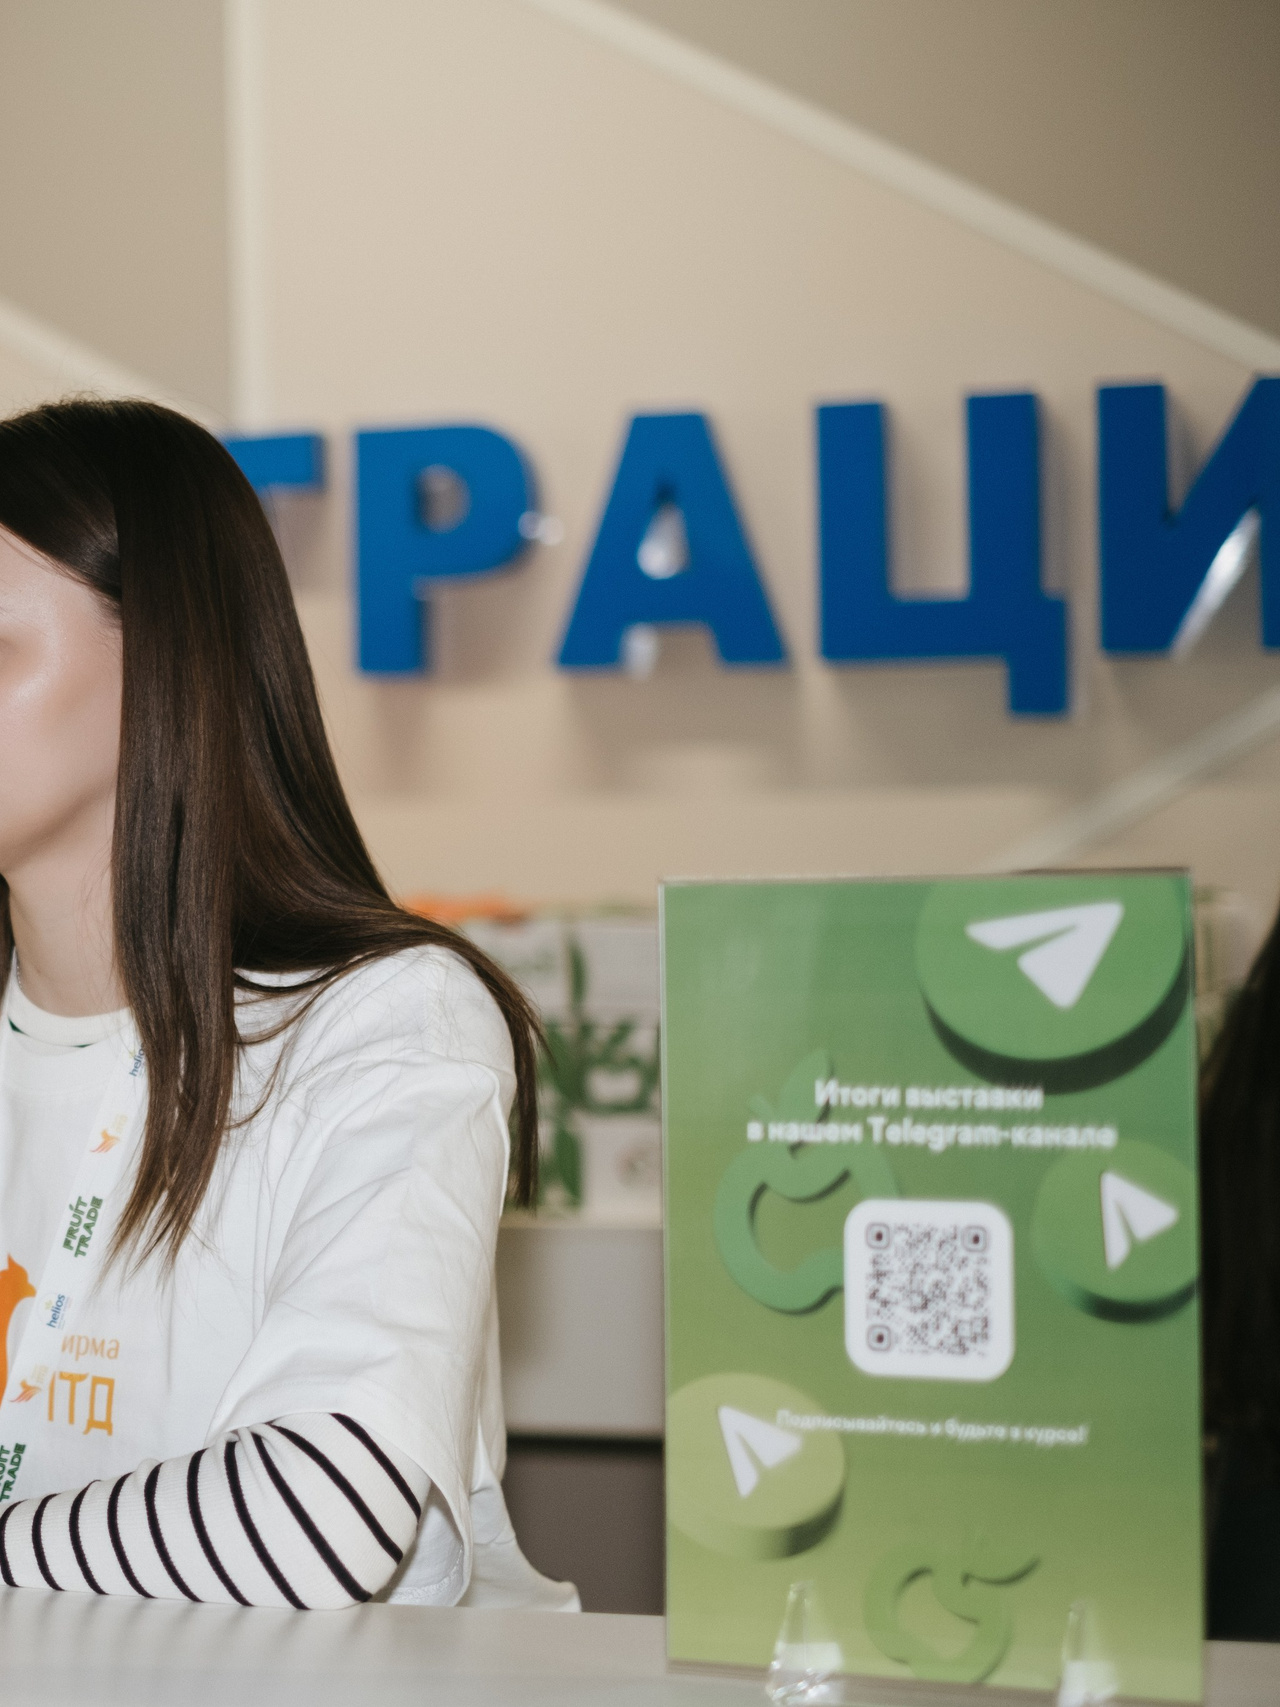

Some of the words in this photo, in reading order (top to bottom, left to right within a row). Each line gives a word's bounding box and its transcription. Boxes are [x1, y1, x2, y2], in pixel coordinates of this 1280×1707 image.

[815, 1078, 900, 1107] Итоги
[906, 1087, 1043, 1109] выставки
[747, 1122, 763, 1141] в
[768, 1122, 862, 1142] нашем
[867, 1114, 1118, 1153] Telegram-канале
[73, 1195, 104, 1258] TRADE
[46, 1293, 66, 1328] helios
[60, 1333, 121, 1361] ирма
